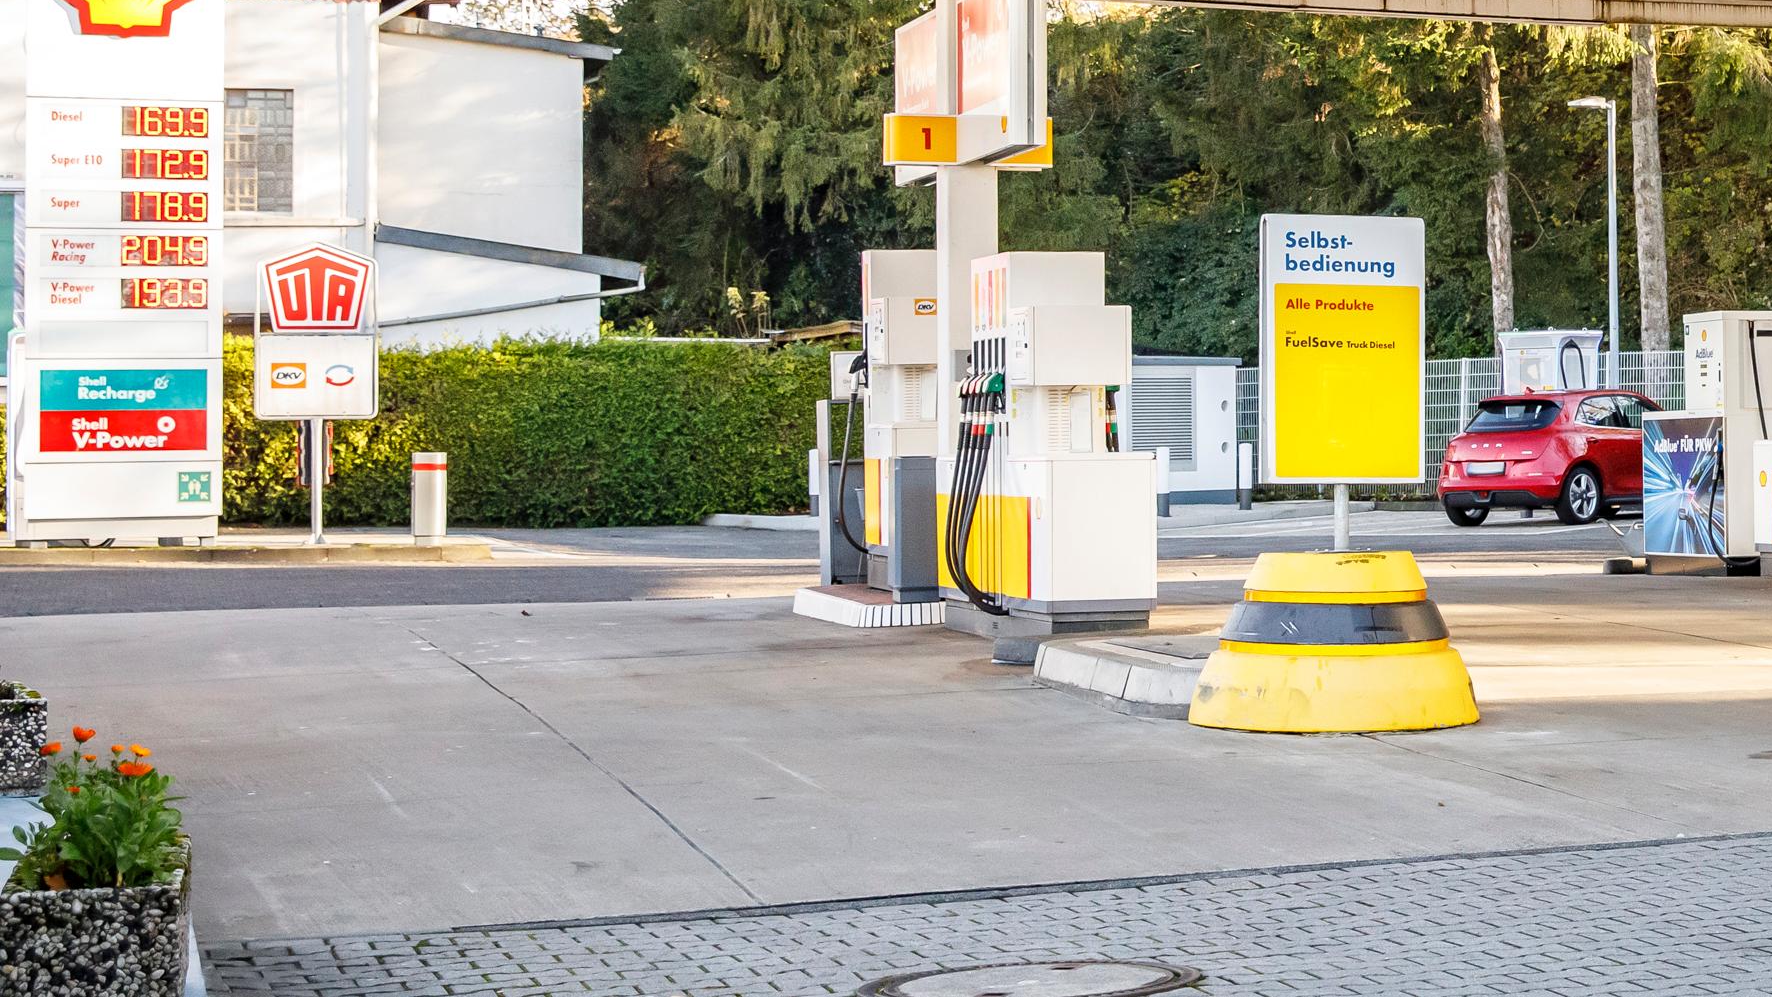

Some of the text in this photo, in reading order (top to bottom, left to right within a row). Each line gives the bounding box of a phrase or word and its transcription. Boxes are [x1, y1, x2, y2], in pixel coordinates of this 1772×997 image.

[51, 106, 208, 136] Diesel 169.9
[921, 127, 932, 150] 1
[51, 149, 208, 179] Super E10 172.9
[51, 192, 207, 221] Super 178.9
[1285, 231, 1353, 249] Selbst-
[51, 235, 208, 265] V-Power 204.9
[51, 251, 87, 264] Racing
[1285, 253, 1395, 278] bedienung
[51, 278, 207, 307] V-Power 193.9
[276, 255, 359, 322] UTA
[51, 294, 82, 304] Diesel
[1286, 298, 1375, 311] Alle Produkte
[1285, 336, 1395, 349] FuelSave Truck Diesel
[1695, 348, 1714, 358] AdBlue
[78, 376, 107, 386] Shell
[276, 372, 302, 380] DKV
[77, 386, 156, 403] Recharge
[72, 417, 108, 431] Shell
[72, 431, 168, 449] V-Power
[1680, 435, 1694, 453] FÜR
[1694, 437, 1713, 453] PKW
